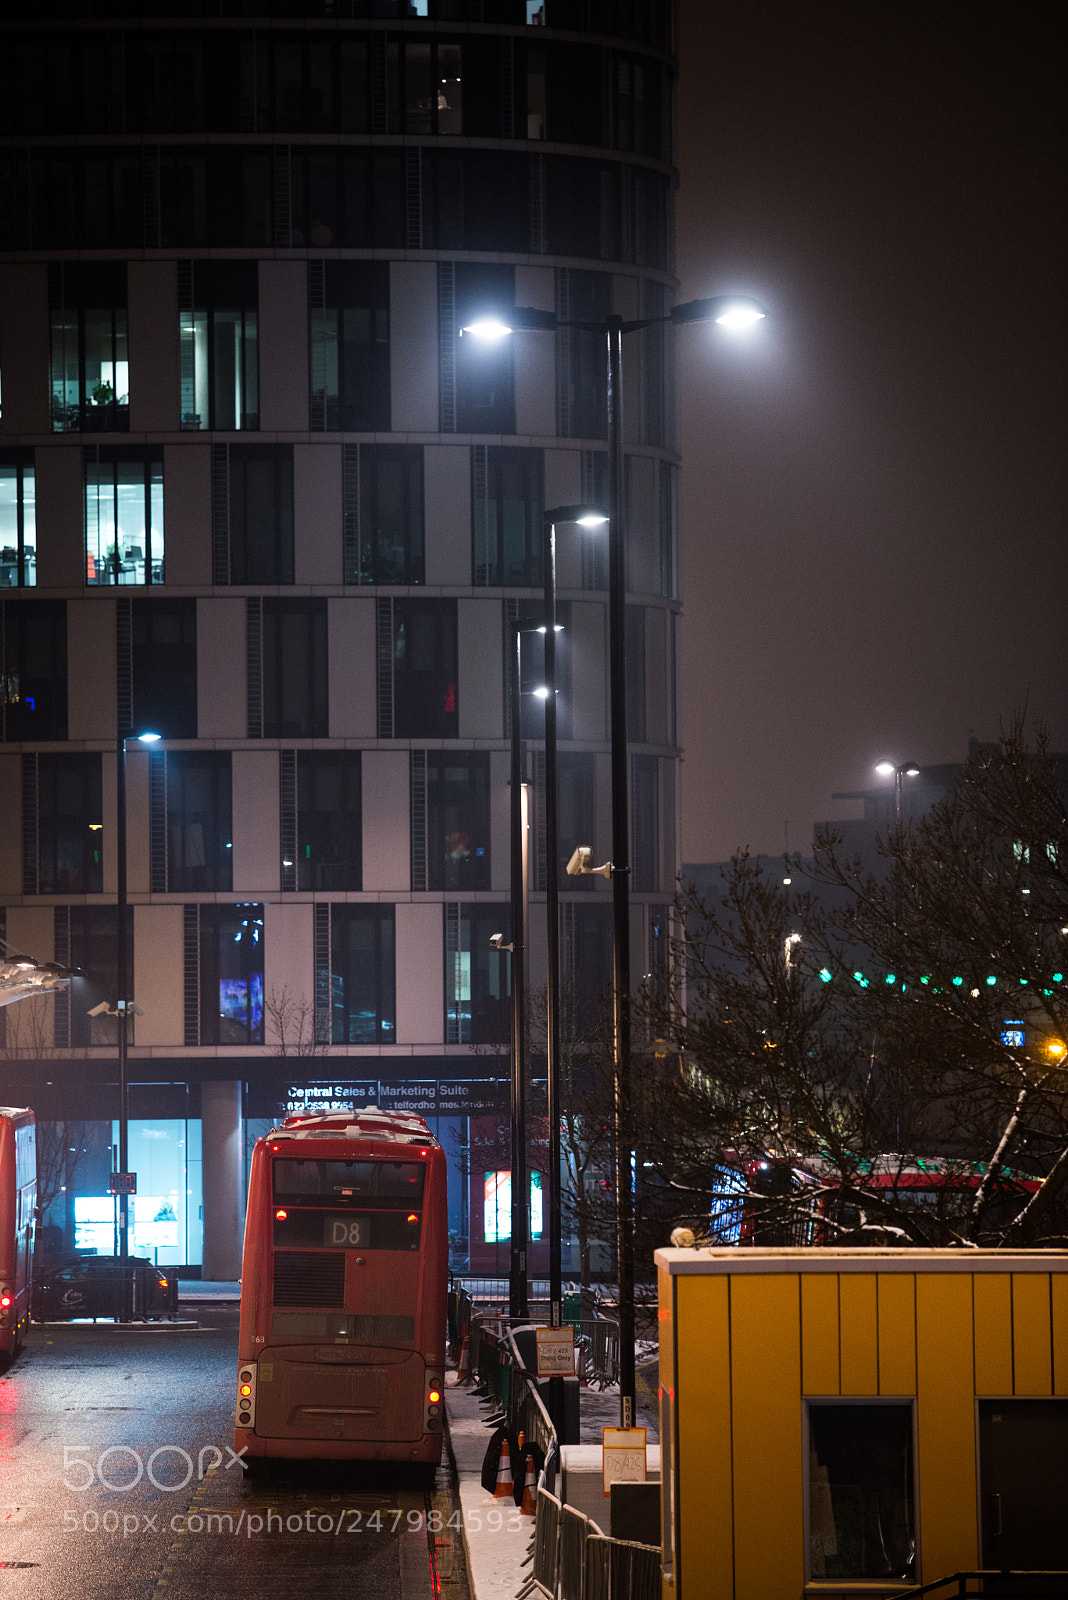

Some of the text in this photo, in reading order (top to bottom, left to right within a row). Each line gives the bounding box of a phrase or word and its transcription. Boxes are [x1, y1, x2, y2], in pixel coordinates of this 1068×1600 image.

[287, 1085, 469, 1098] Central Sales & Marketing Suite
[332, 1221, 360, 1245] D8
